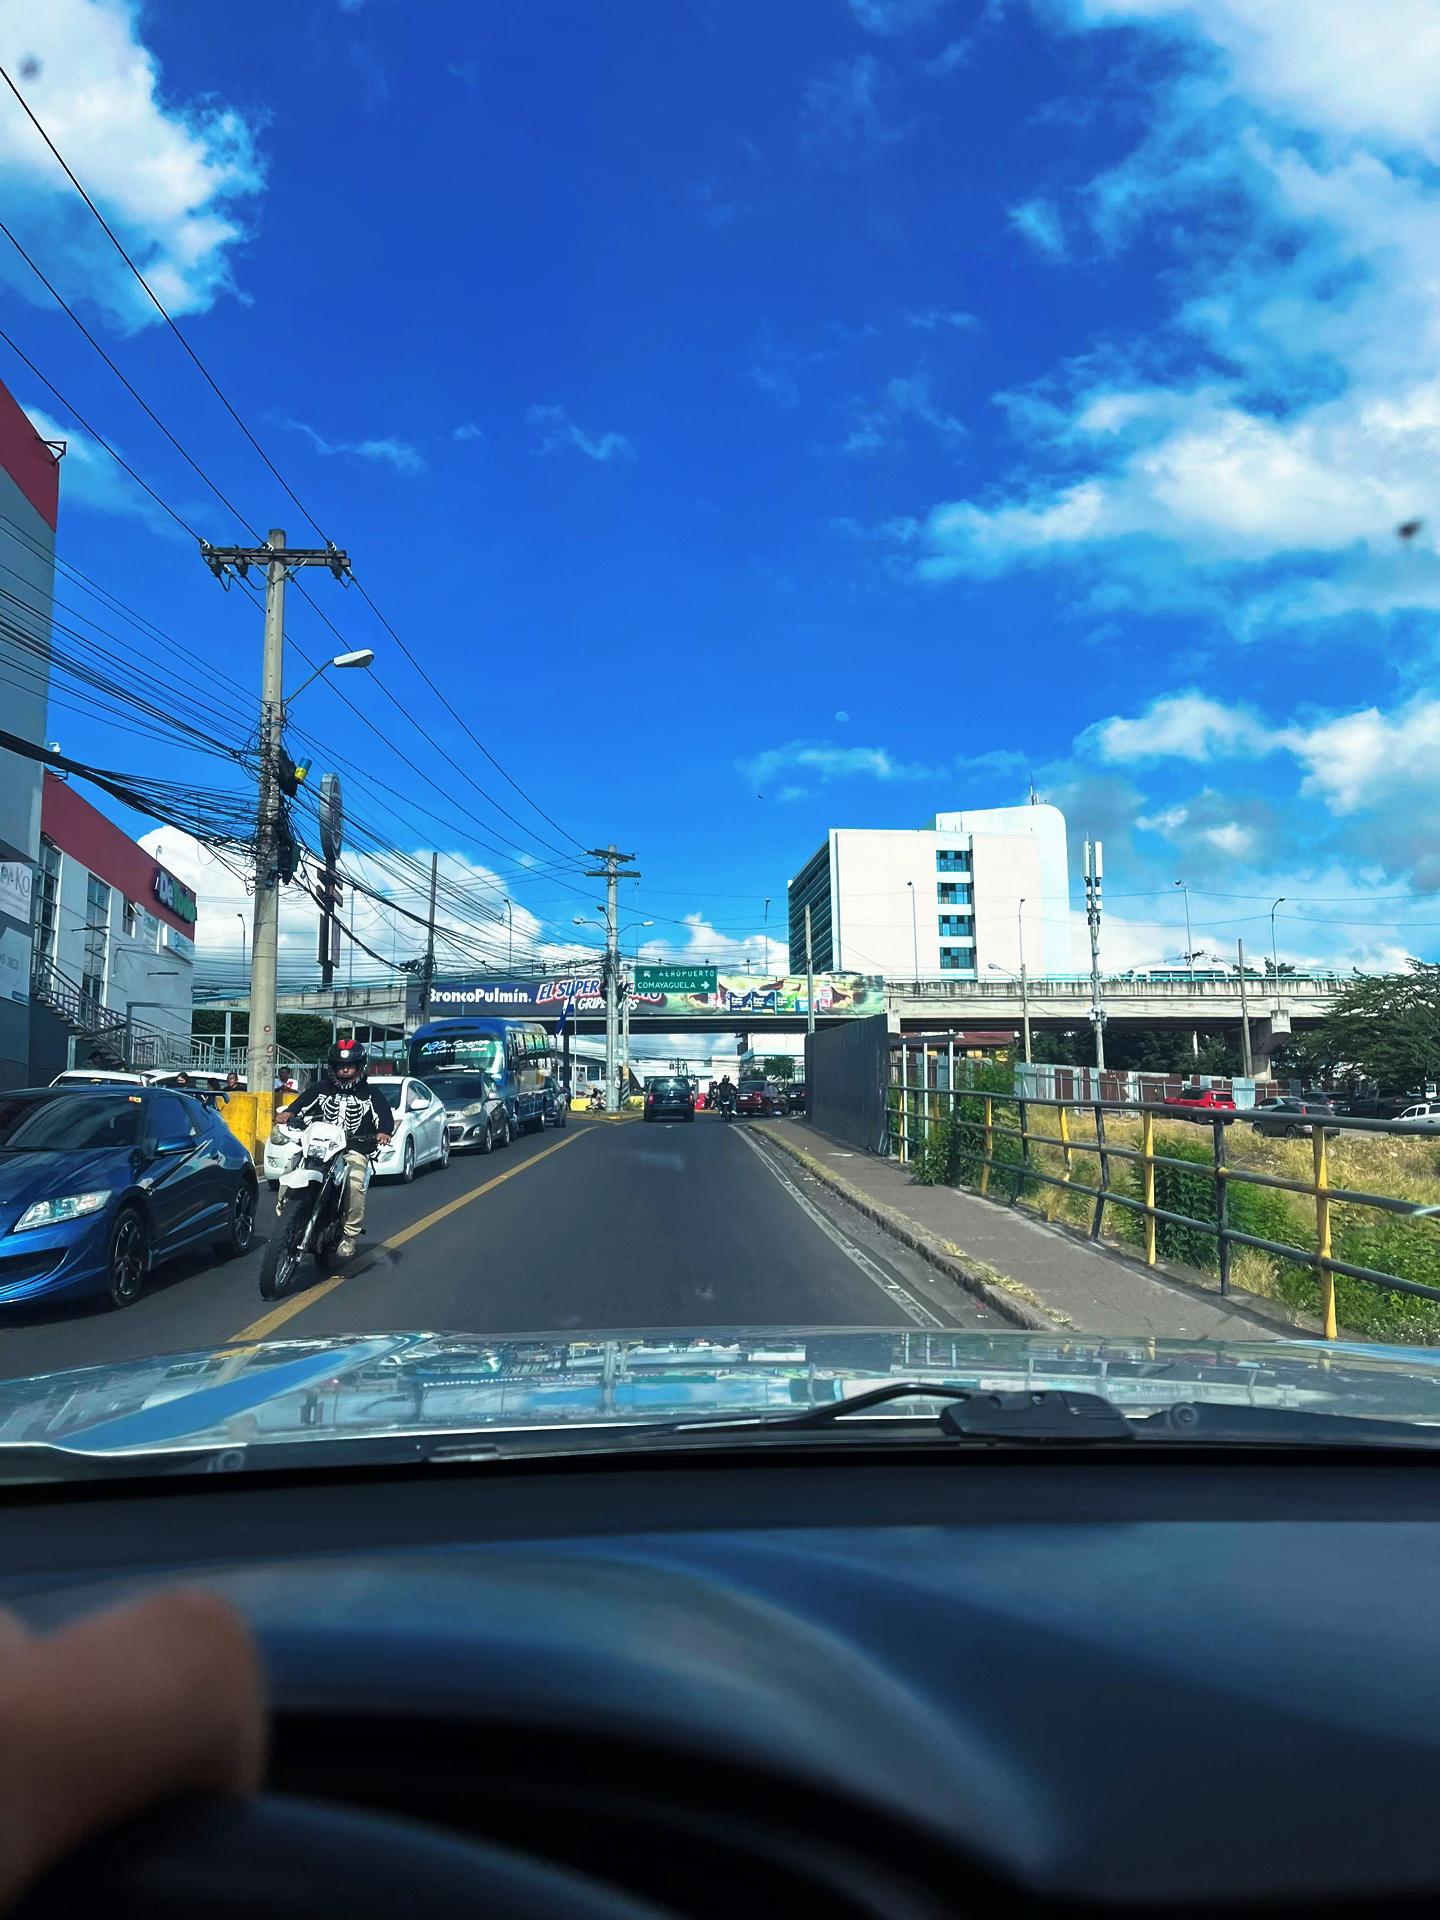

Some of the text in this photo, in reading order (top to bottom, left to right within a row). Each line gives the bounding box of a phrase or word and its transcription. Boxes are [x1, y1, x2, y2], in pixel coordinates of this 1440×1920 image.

[540, 982, 555, 1001] EL
[555, 978, 601, 999] SUPER
[637, 981, 696, 989] COMAYAGUELA
